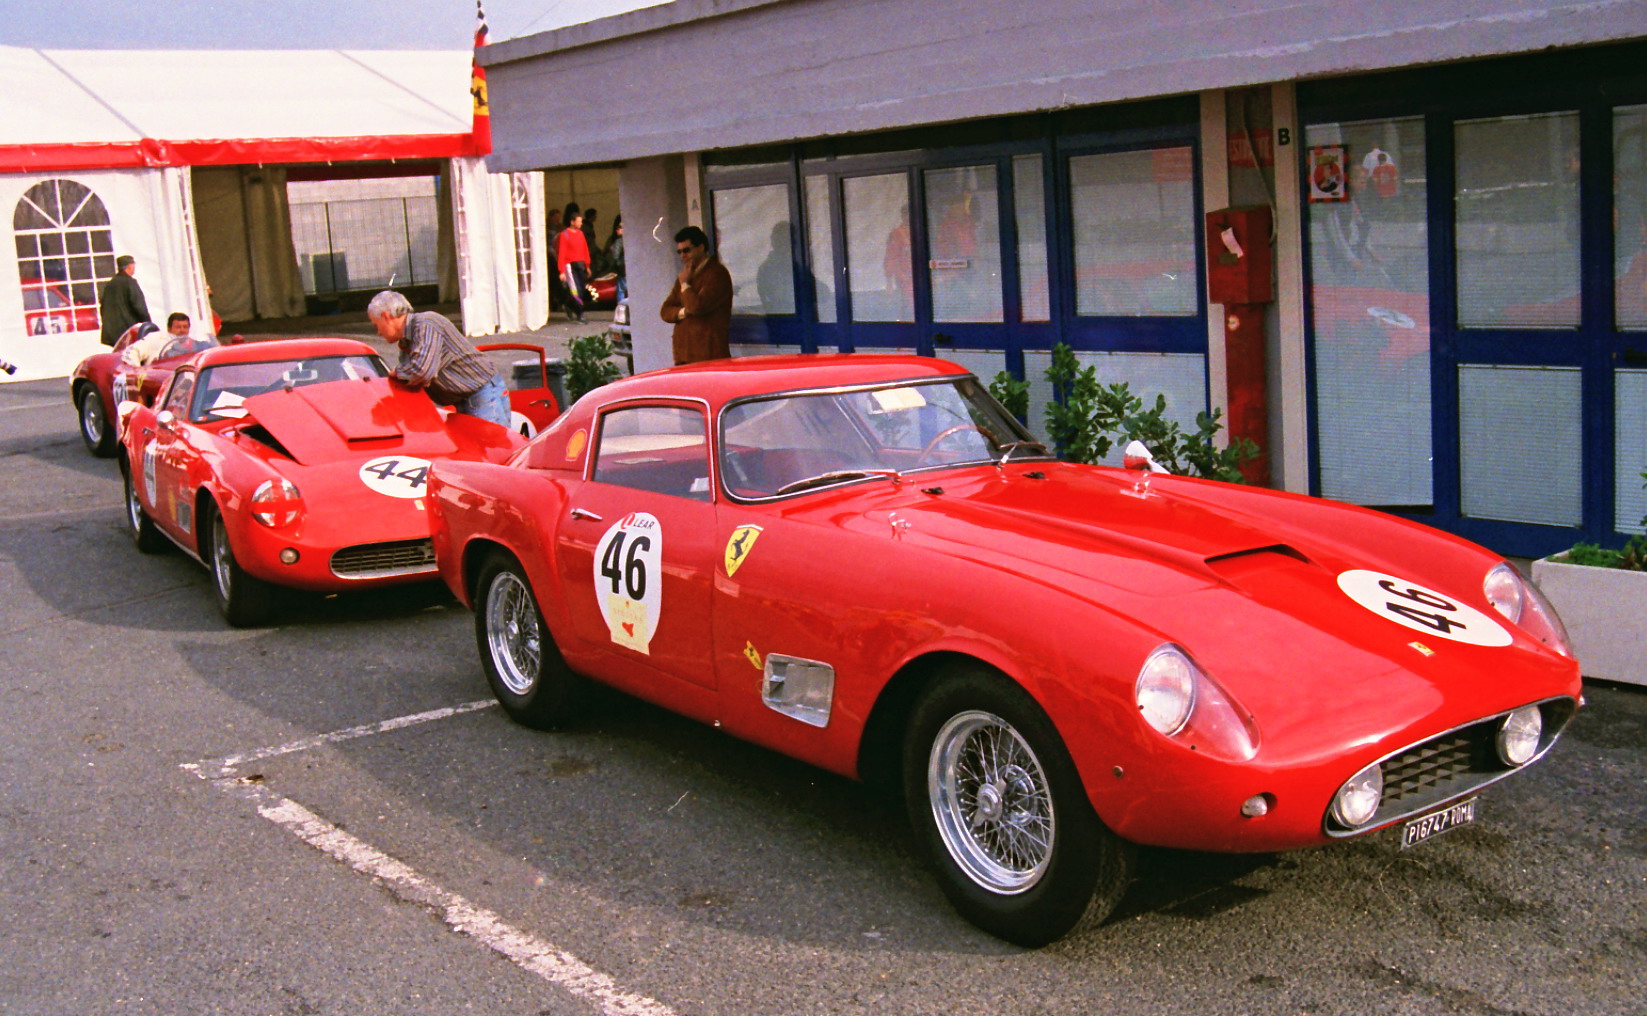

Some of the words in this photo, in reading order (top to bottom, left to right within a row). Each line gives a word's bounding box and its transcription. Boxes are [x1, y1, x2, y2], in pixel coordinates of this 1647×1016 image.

[1278, 128, 1291, 146] B
[691, 199, 700, 211] A
[364, 460, 428, 488] 44
[633, 519, 656, 530] LEAR
[601, 530, 651, 601] 46
[1378, 579, 1467, 634] 46
